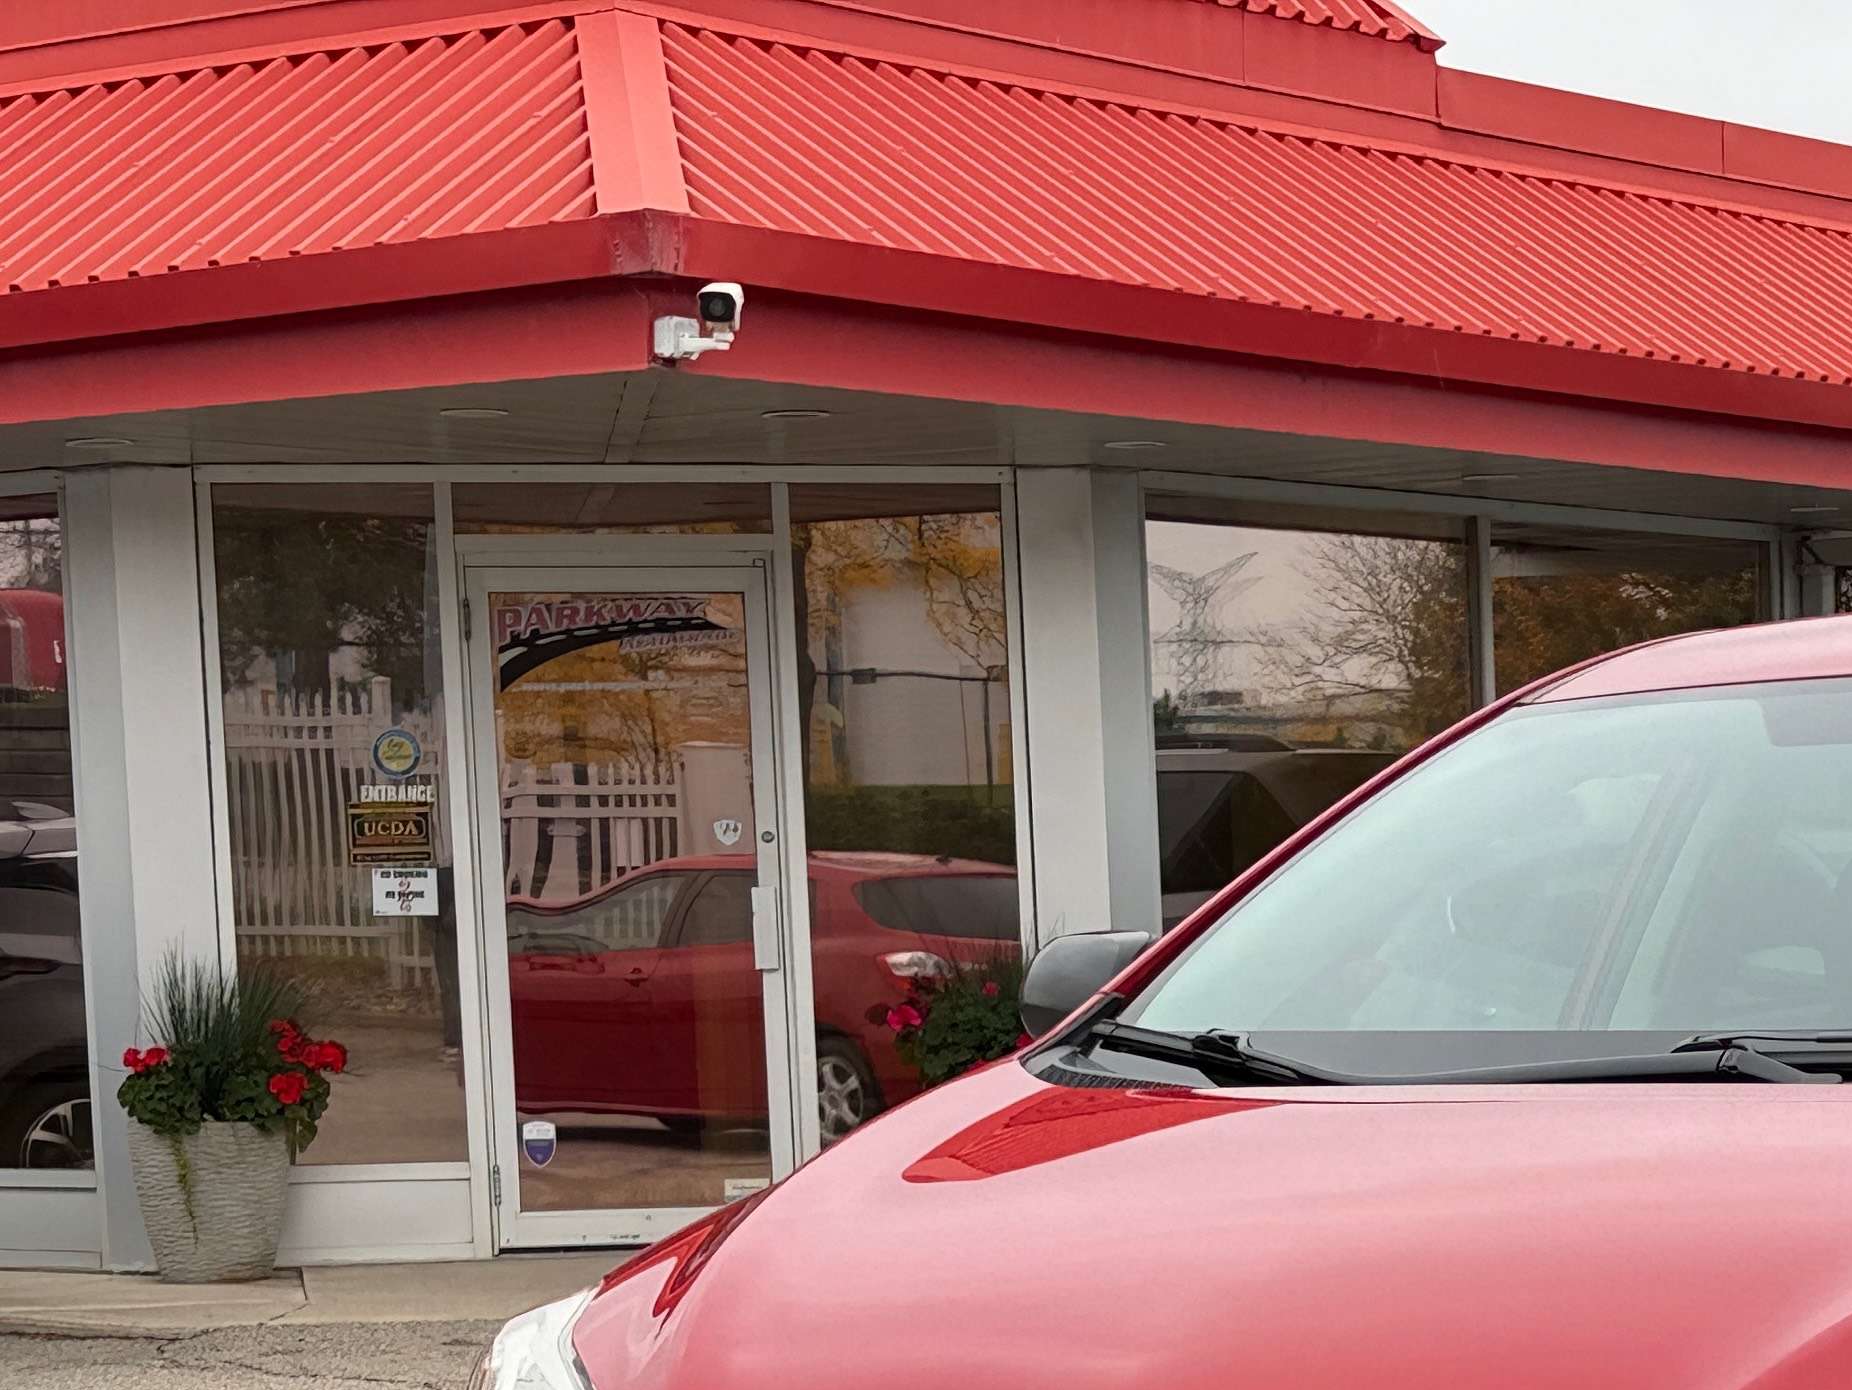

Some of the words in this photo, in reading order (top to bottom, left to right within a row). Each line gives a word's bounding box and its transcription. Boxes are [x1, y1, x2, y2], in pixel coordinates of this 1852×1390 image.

[497, 600, 708, 644] PARKWAY
[360, 784, 435, 803] ENTRANCE
[364, 821, 418, 836] UCDA
